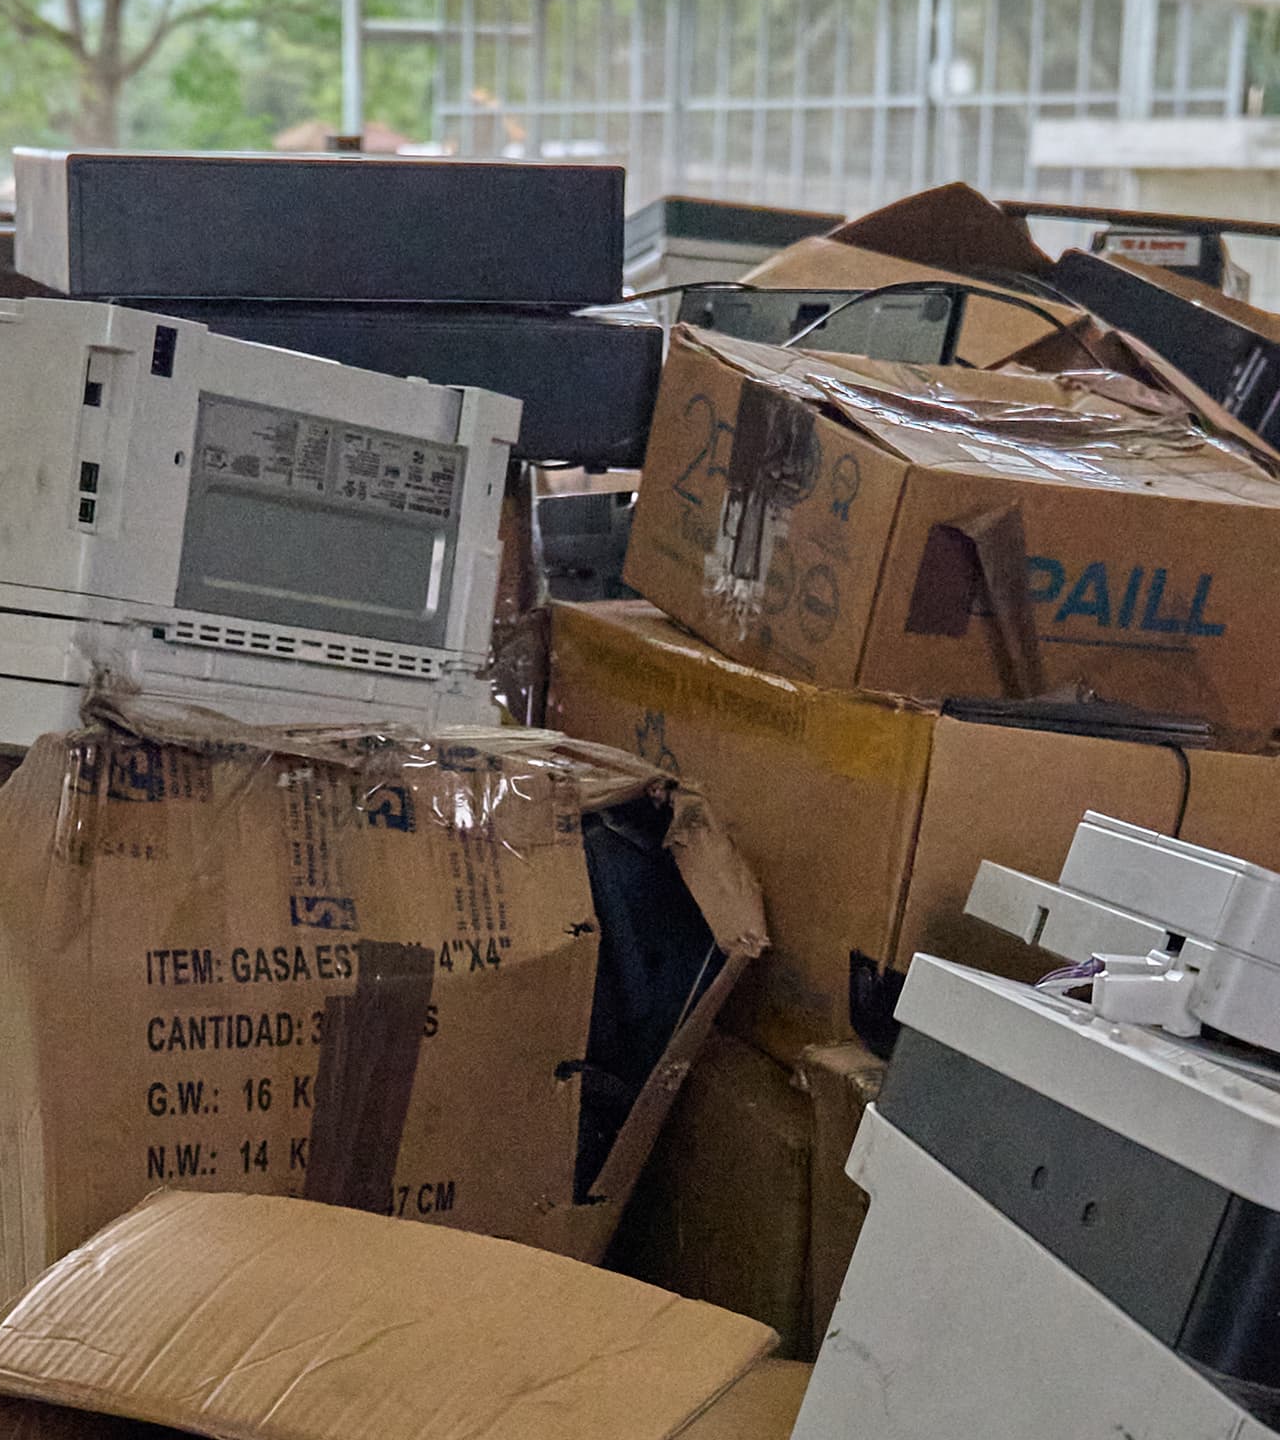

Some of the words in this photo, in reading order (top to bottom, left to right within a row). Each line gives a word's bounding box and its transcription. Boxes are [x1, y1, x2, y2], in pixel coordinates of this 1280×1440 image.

[147, 948, 223, 985] ITEM:
[231, 945, 310, 984] GASA
[147, 1012, 303, 1052] CANTIDAD:
[147, 1080, 219, 1117] G.W.:
[242, 1077, 272, 1113] 16
[147, 1143, 218, 1180] N.W.:
[239, 1140, 268, 1174] 14
[418, 1180, 456, 1215] CM
